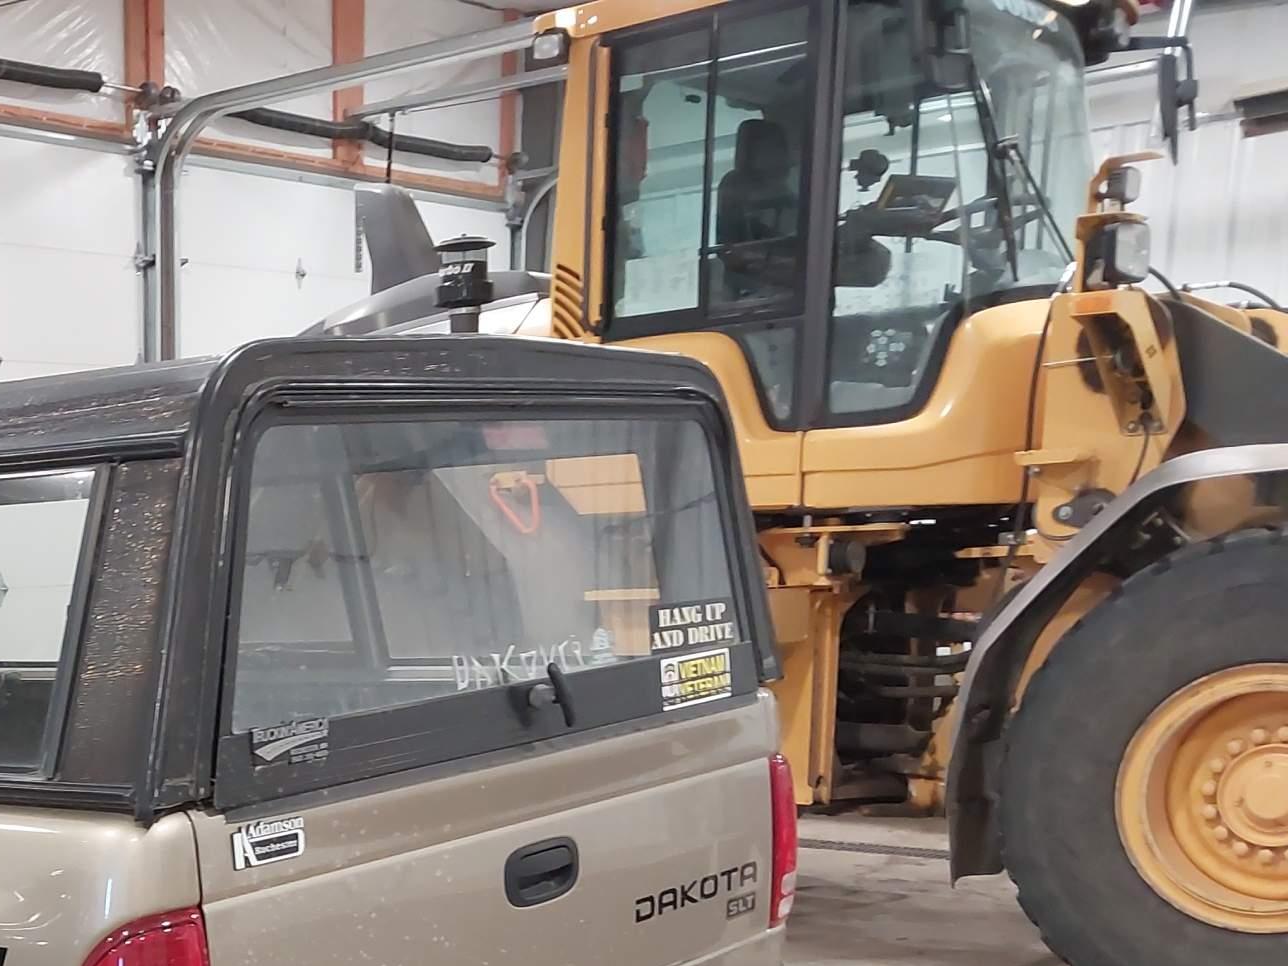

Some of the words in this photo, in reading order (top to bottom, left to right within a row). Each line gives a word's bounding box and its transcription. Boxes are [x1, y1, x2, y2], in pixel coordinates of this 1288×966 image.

[658, 605, 703, 628] HANG
[705, 602, 726, 621] UP
[652, 629, 684, 650] AND
[687, 622, 734, 645] DRIVE
[247, 817, 304, 839] Adamson
[635, 861, 757, 923] DAKOTA
[728, 894, 755, 917] SLT
